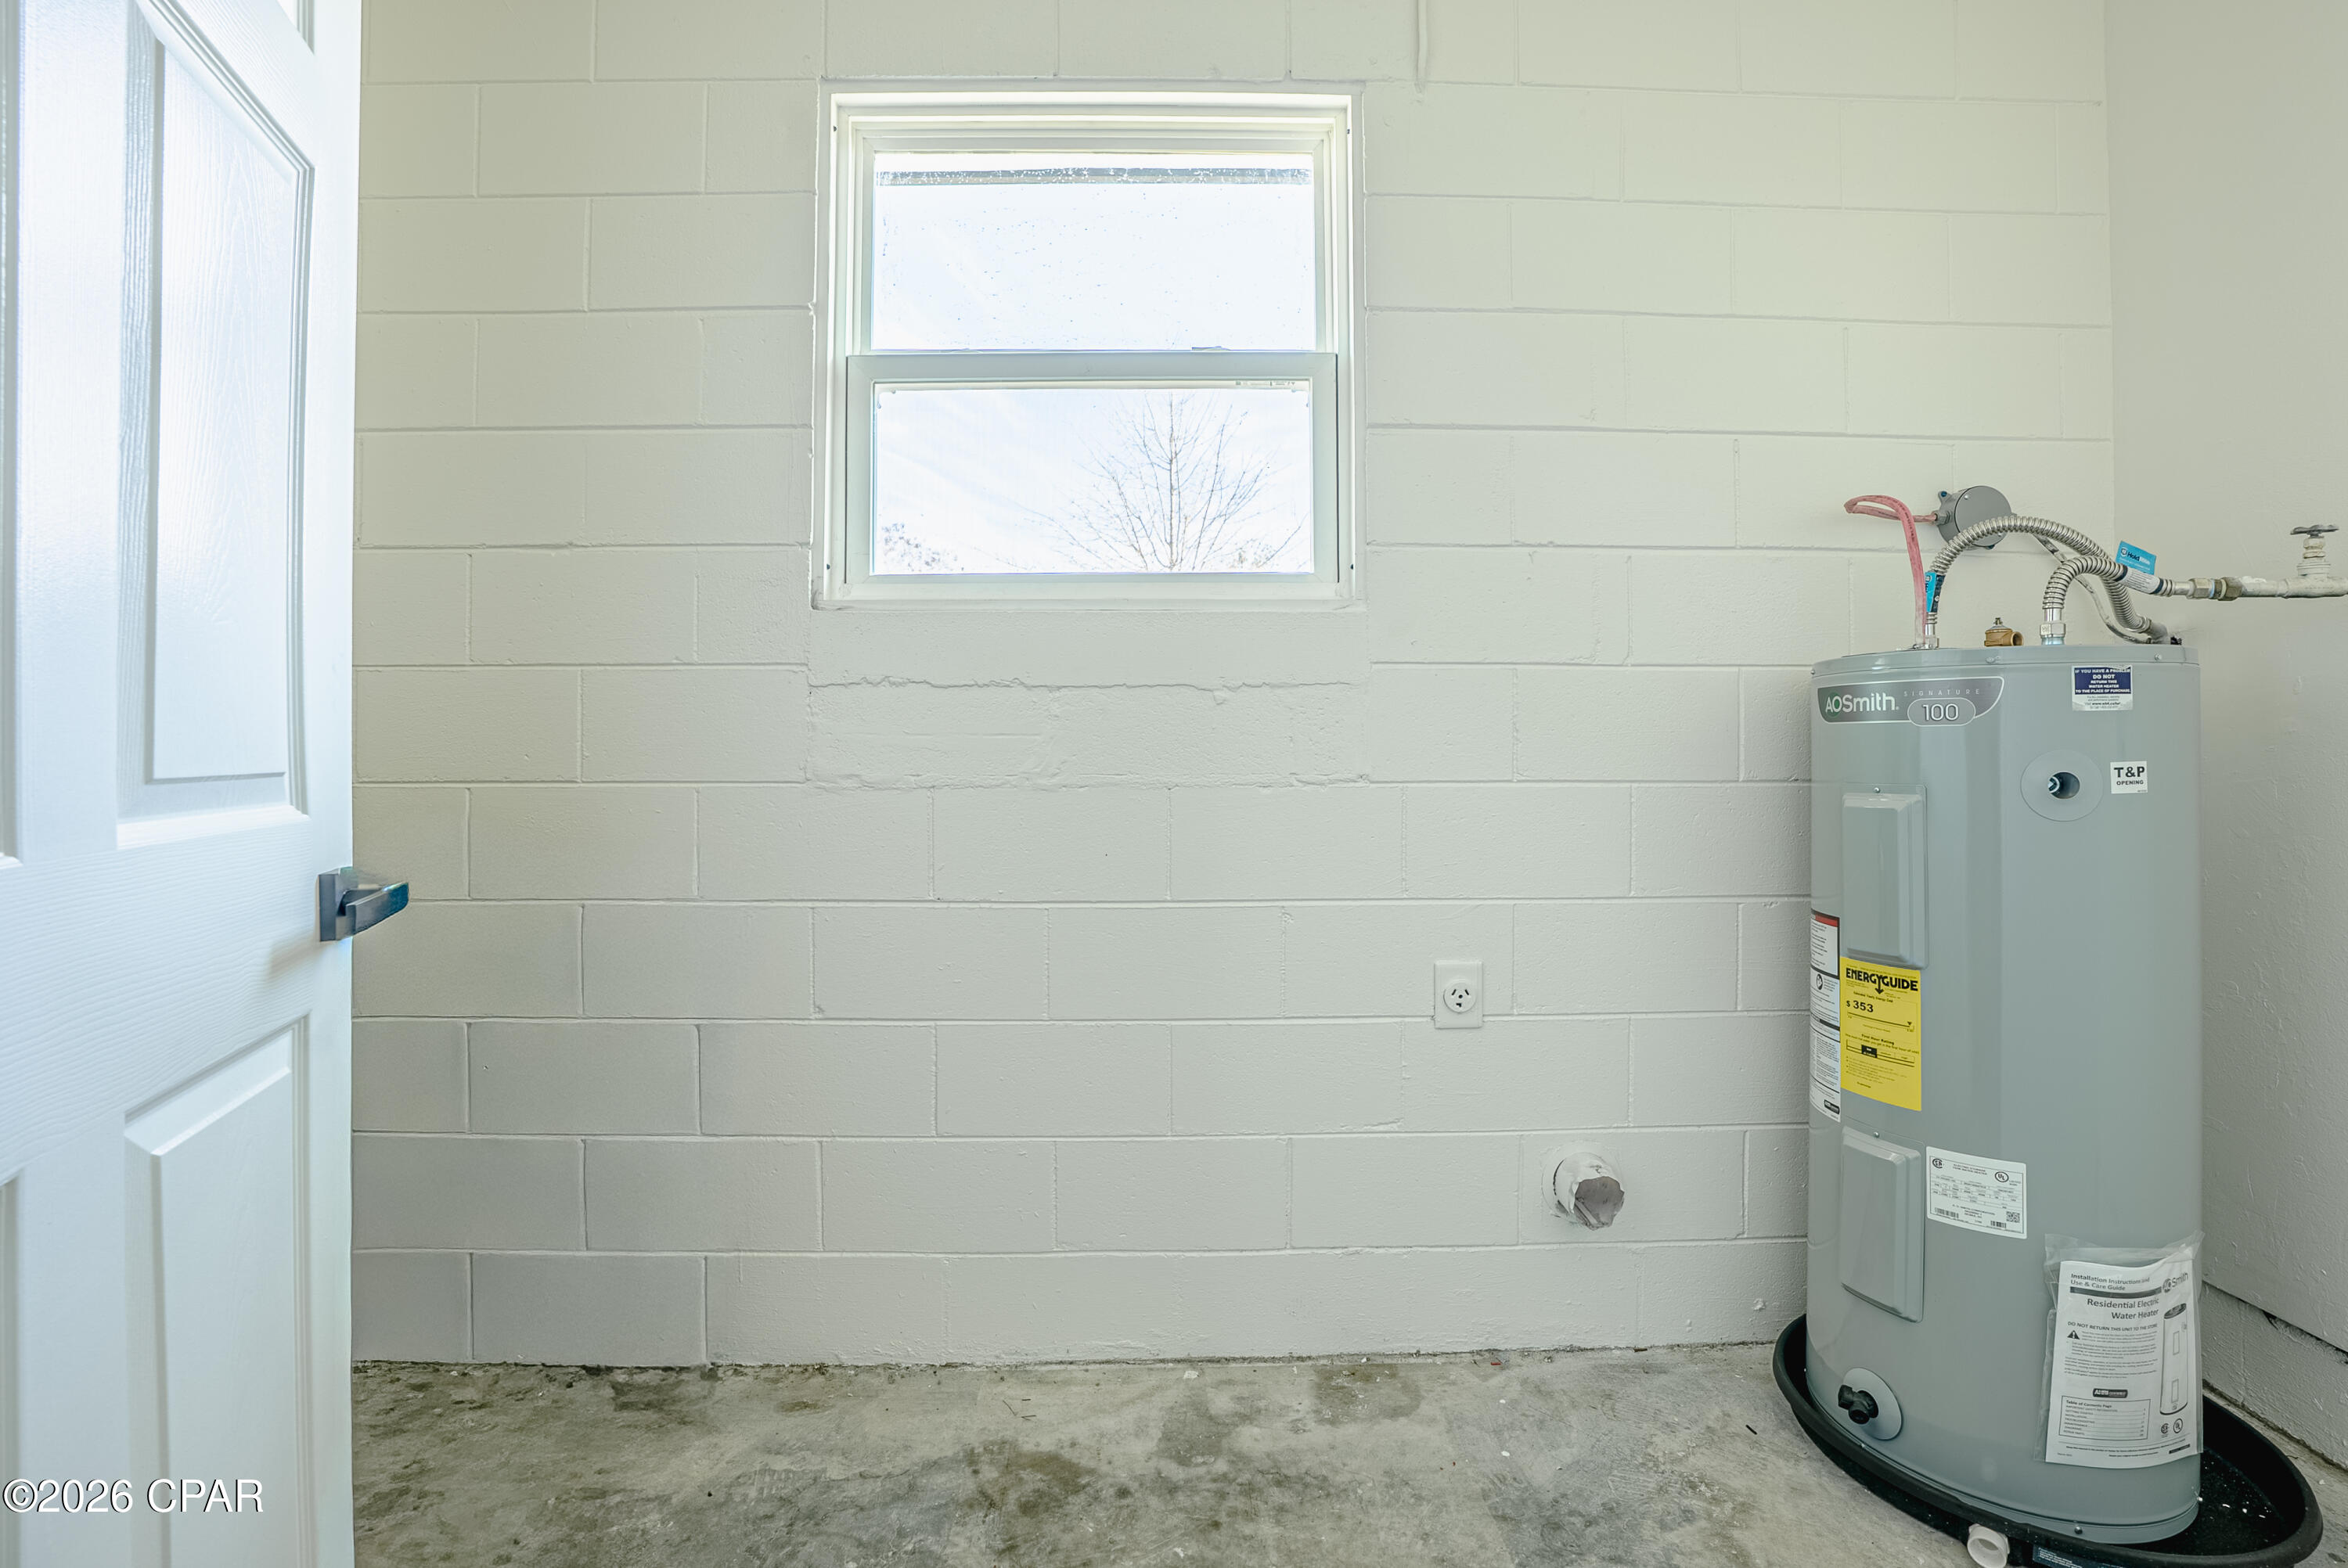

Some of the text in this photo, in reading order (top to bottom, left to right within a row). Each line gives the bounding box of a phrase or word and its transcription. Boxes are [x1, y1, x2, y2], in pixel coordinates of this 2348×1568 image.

[1903, 689, 1980, 697] SIGNATURE
[1923, 704, 1959, 721] 100
[2114, 766, 2145, 777] T&P
[1846, 967, 1918, 992] ENERGYGUIDE
[2071, 1273, 2107, 1283] Installation
[2087, 1297, 2159, 1309] Residential Electric
[2138, 1309, 2159, 1318] Heater
